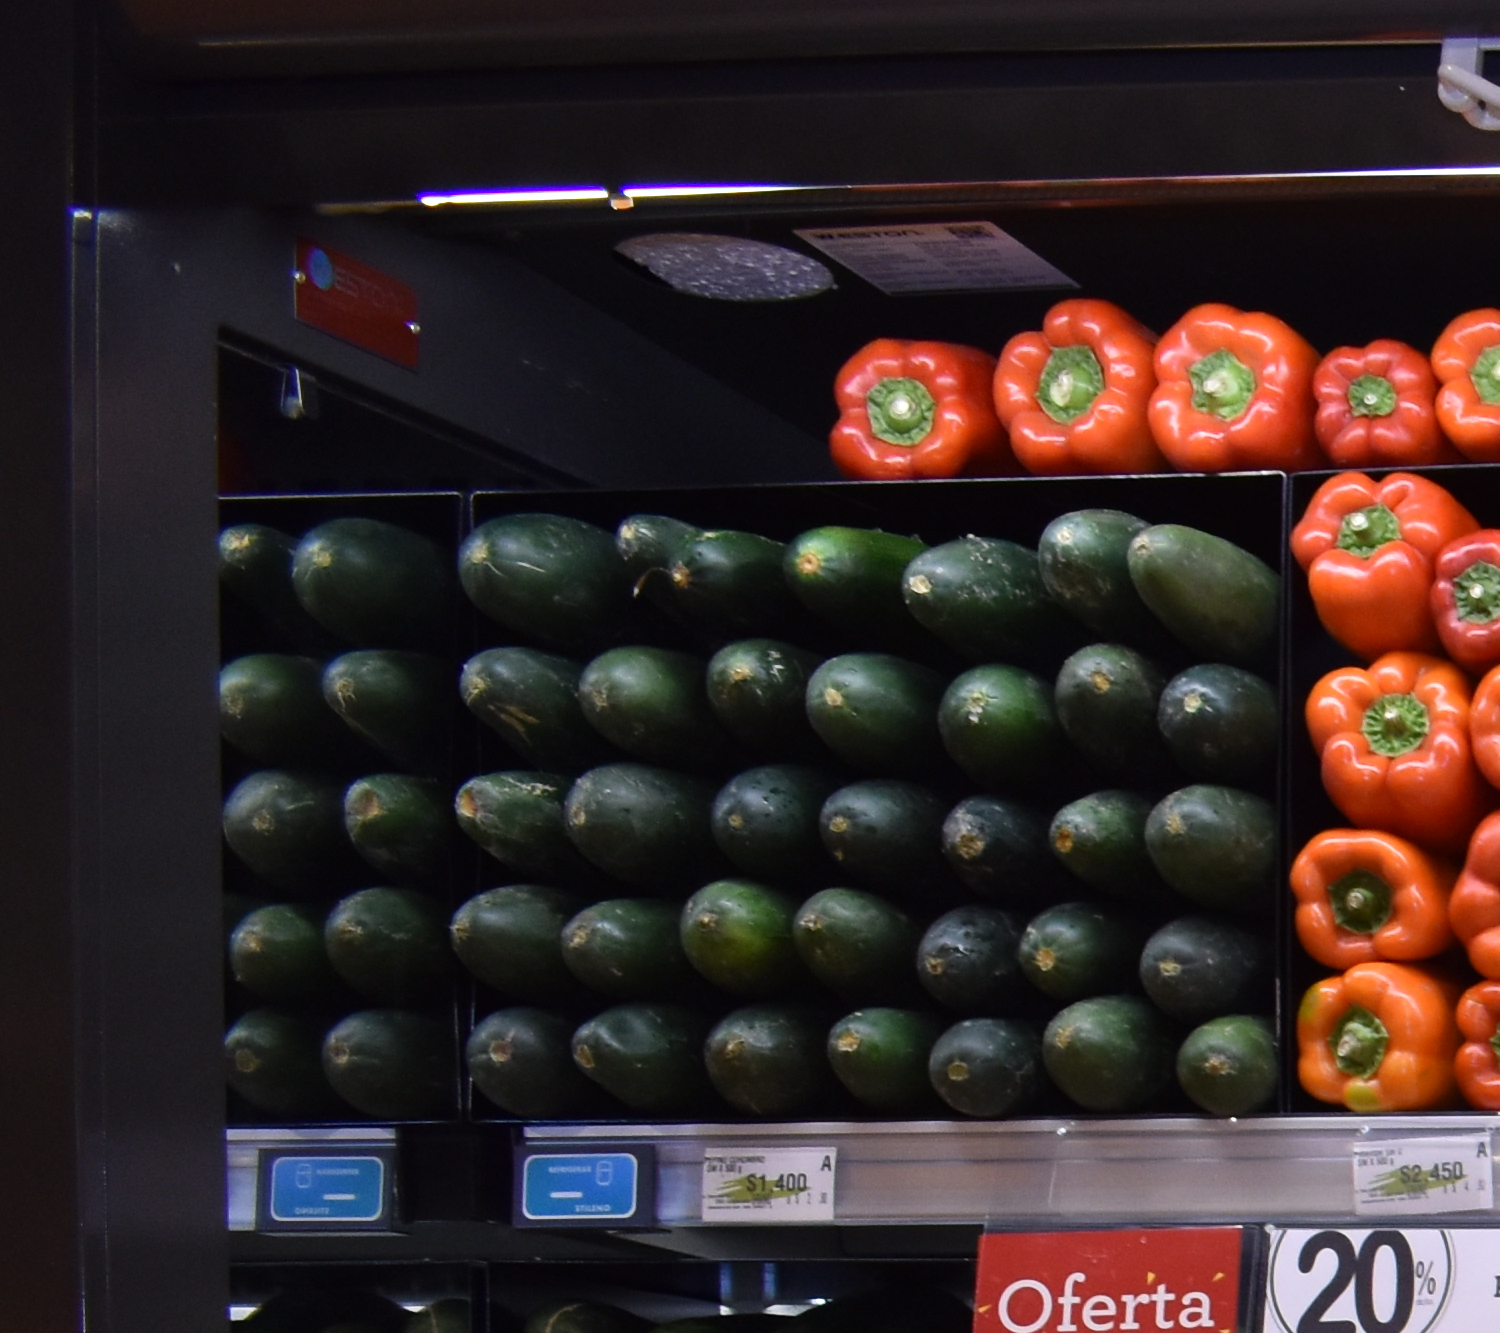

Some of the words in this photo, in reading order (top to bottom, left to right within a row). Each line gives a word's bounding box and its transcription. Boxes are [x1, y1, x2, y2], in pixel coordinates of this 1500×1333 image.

[1477, 1142, 1487, 1158] A
[821, 1156, 832, 1171] A
[1400, 1162, 1463, 1183] $2,450
[999, 1272, 1214, 1333] Oferta
